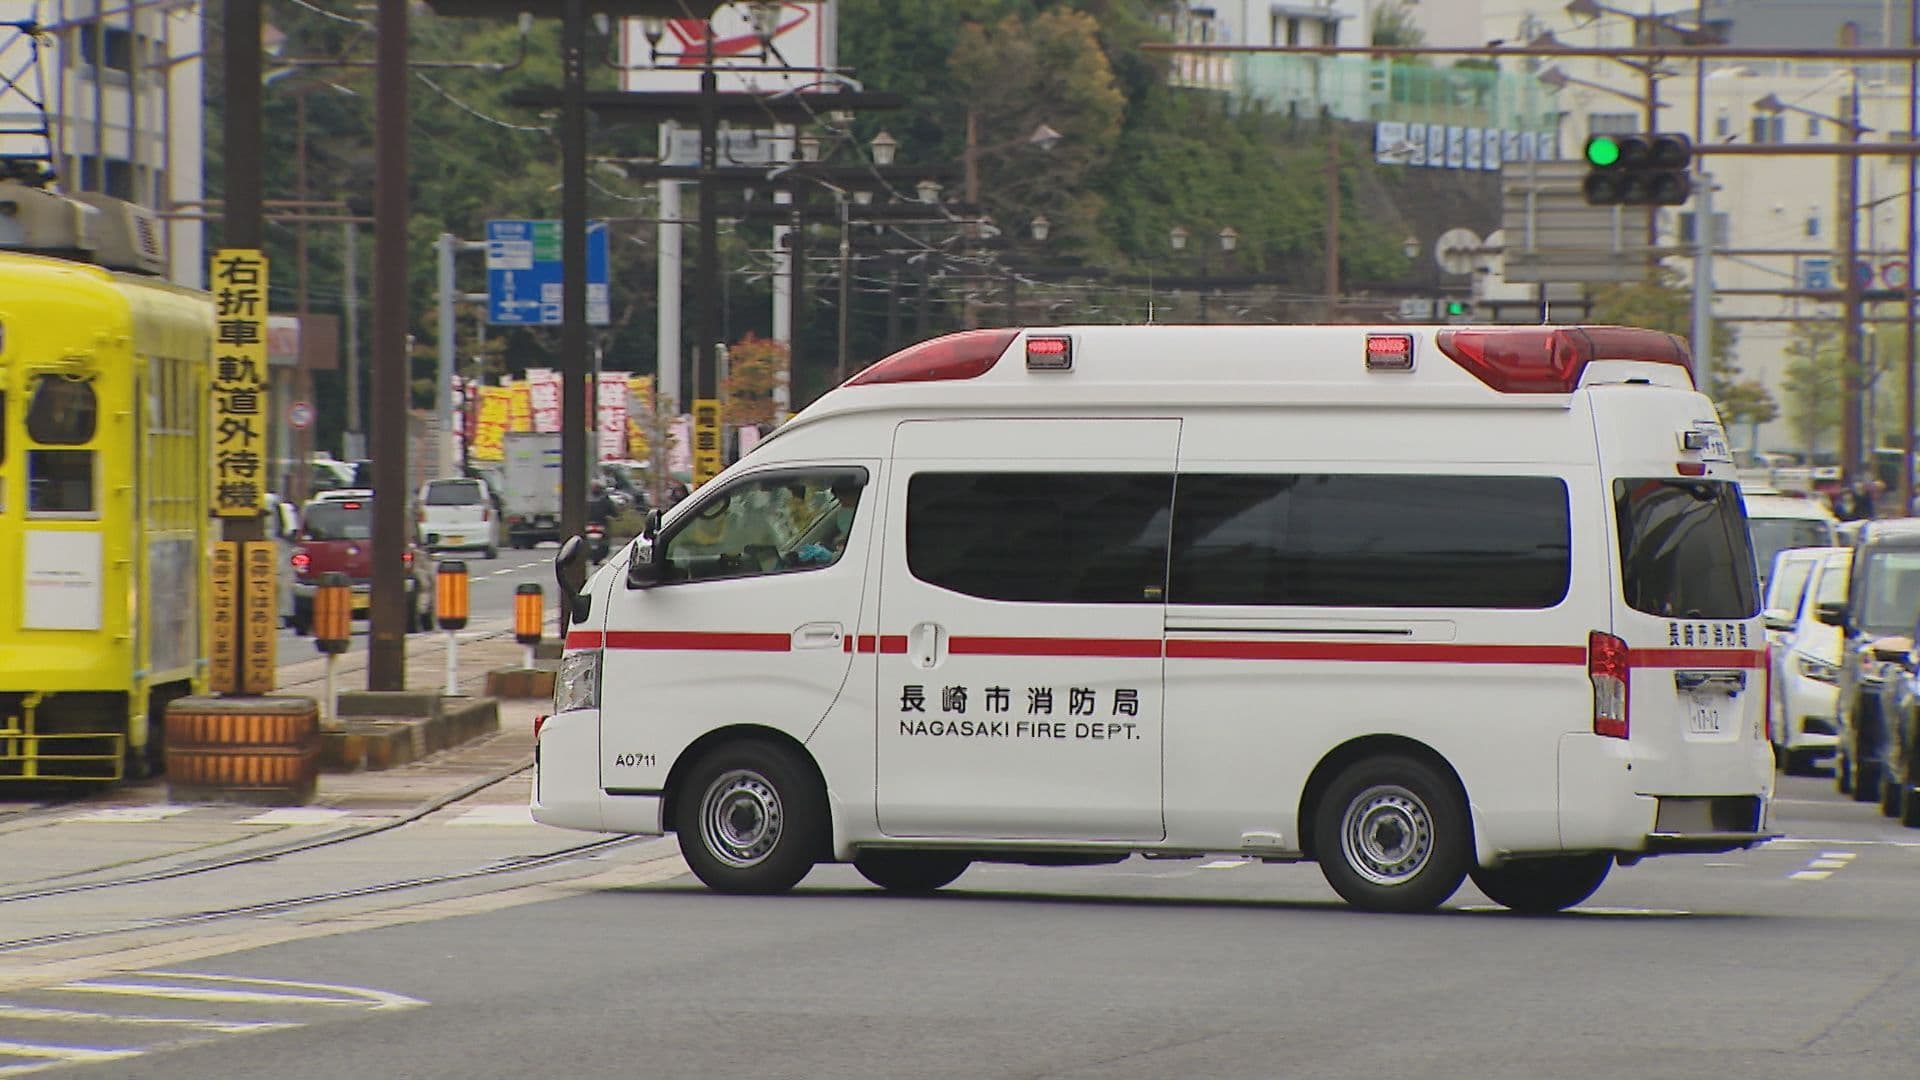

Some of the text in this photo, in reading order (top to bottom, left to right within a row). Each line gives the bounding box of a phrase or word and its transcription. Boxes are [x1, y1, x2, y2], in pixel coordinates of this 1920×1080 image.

[217, 257, 260, 508] 右折車軌道外待機
[1669, 622, 1747, 648] 長崎市消防局
[900, 685, 1139, 716] 長崎市消防局
[900, 721, 1141, 740] NAGASAKI FIRE DEPT.
[615, 753, 656, 767] A0711
